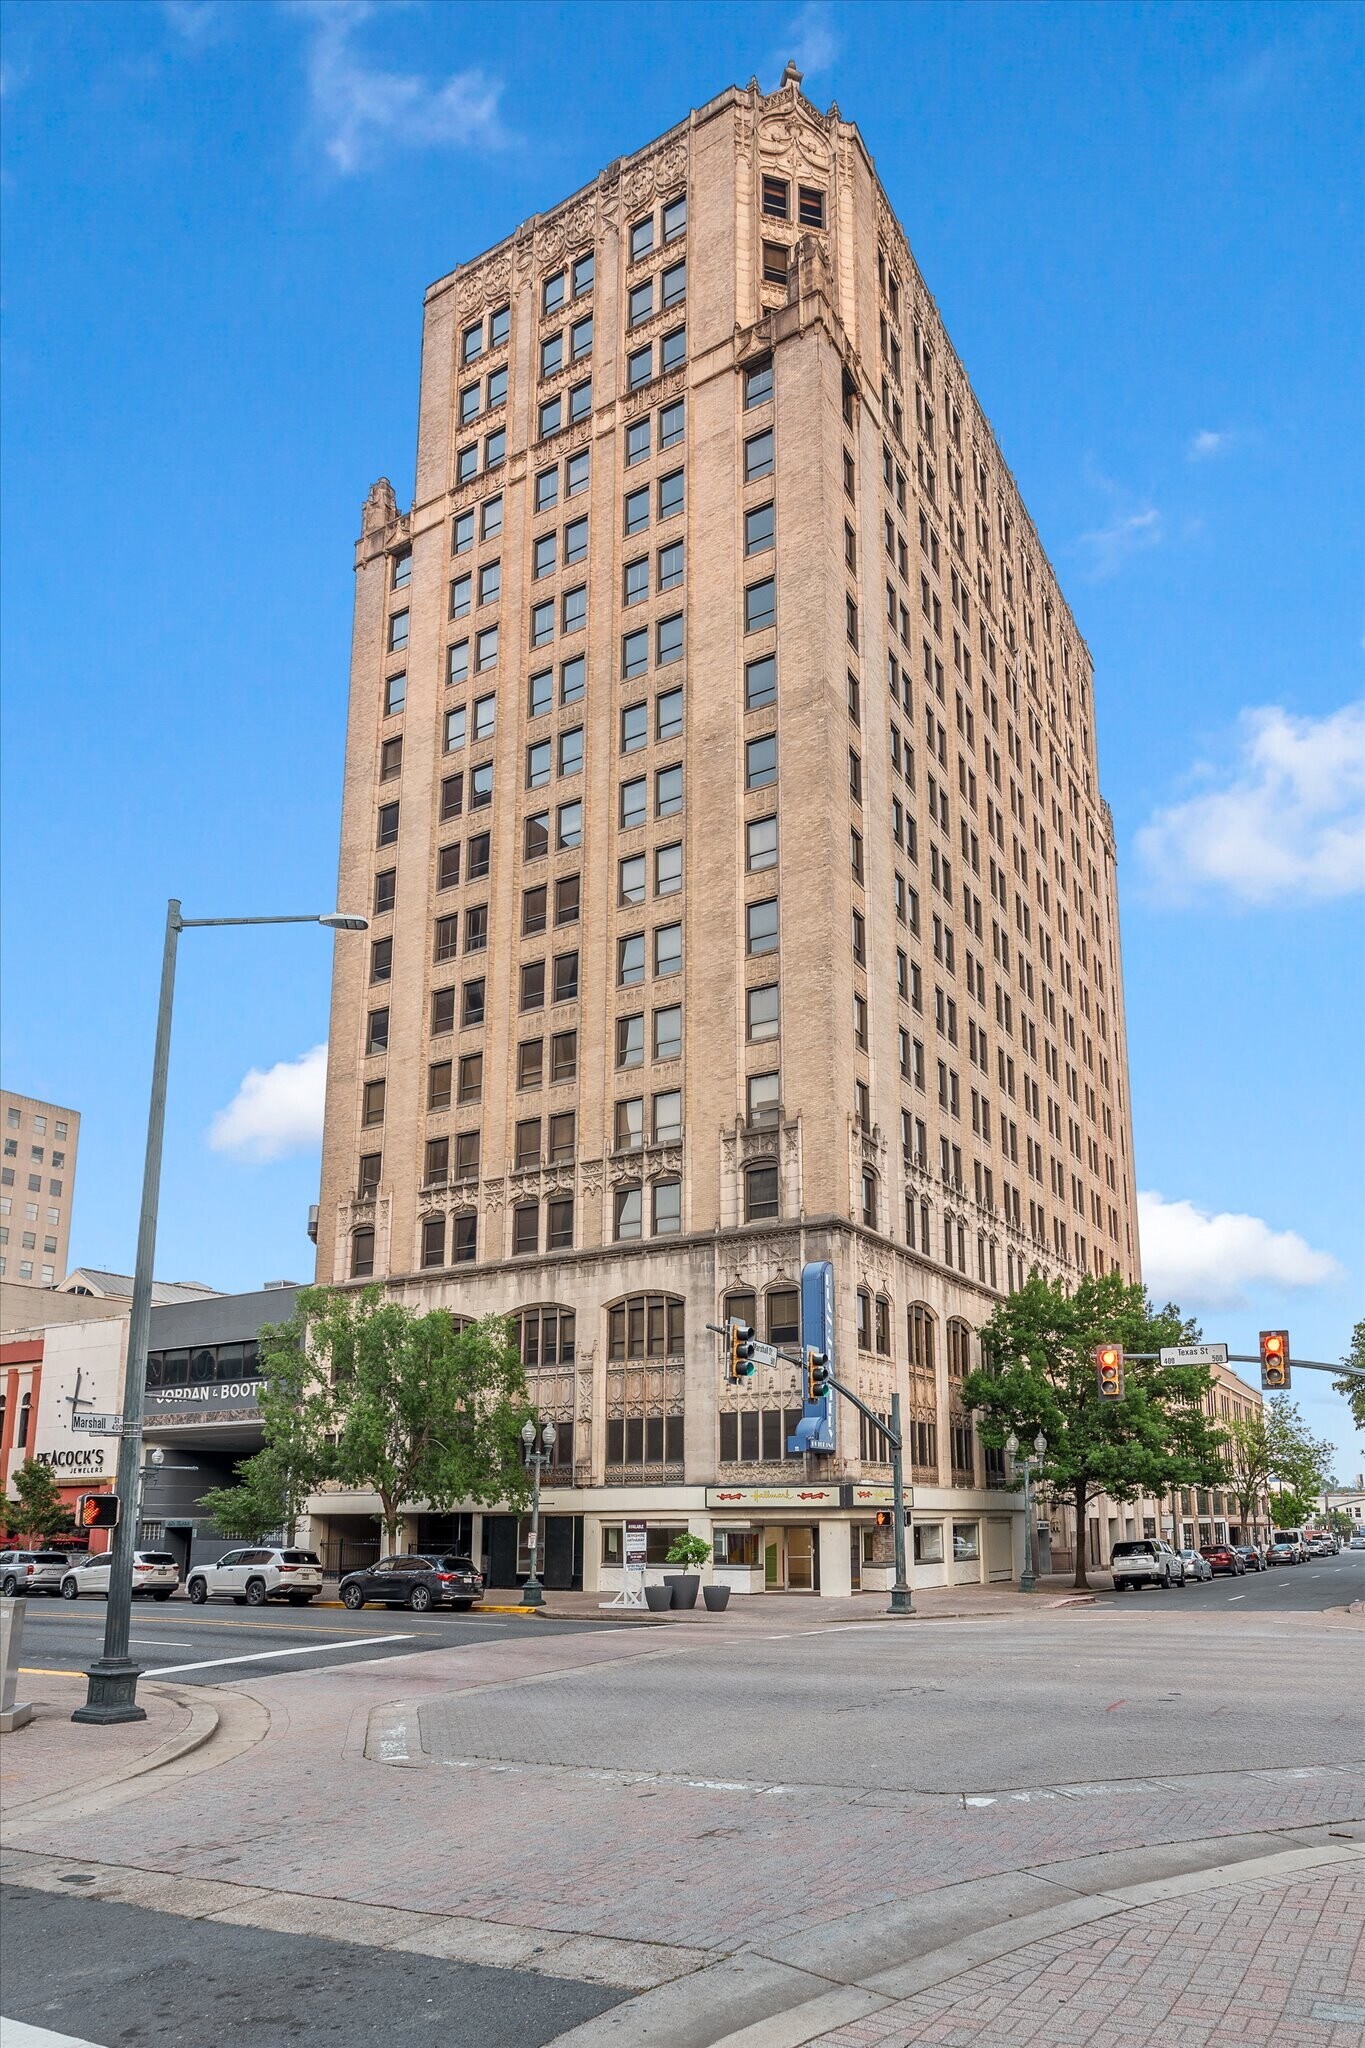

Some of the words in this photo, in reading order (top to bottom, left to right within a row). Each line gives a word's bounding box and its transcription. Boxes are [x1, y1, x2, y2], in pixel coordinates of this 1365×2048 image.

[1178, 1348, 1198, 1356] Texas
[1200, 1347, 1208, 1355] St
[1164, 1357, 1175, 1365] 400
[1212, 1354, 1223, 1362] 500
[157, 1386, 210, 1404] JORDAN
[212, 1388, 219, 1398] &
[73, 1416, 107, 1430] Marshall
[114, 1416, 120, 1424] St
[111, 1424, 123, 1432] 400
[37, 1449, 105, 1467] PEACOCK'S
[69, 1466, 104, 1475] JEWELERS
[751, 1489, 794, 1503] Hallmark
